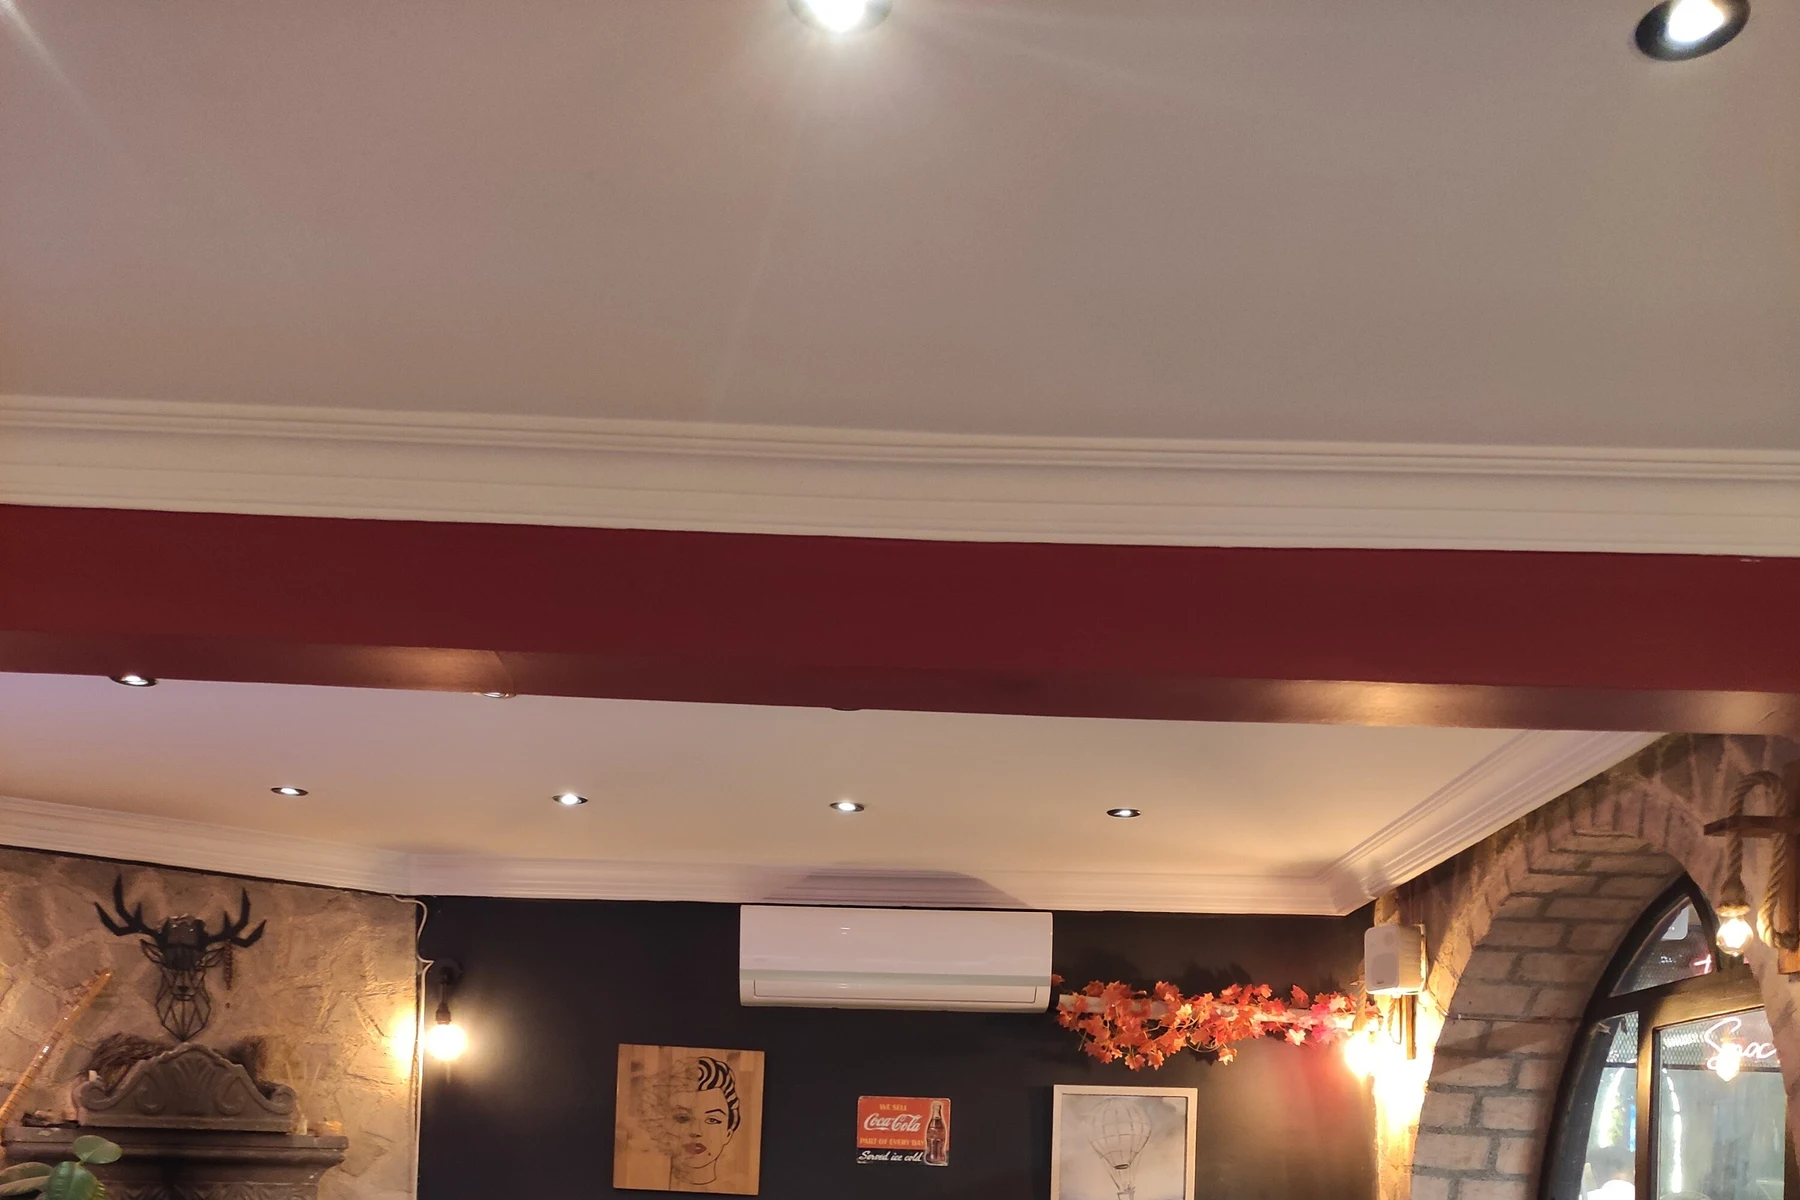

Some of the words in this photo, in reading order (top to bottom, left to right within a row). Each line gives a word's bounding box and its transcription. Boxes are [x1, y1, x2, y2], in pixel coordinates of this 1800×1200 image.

[864, 1113, 922, 1132] Coca-Cola
[858, 1150, 890, 1161] Served
[891, 1152, 902, 1161] ice
[904, 1151, 923, 1162] cold
